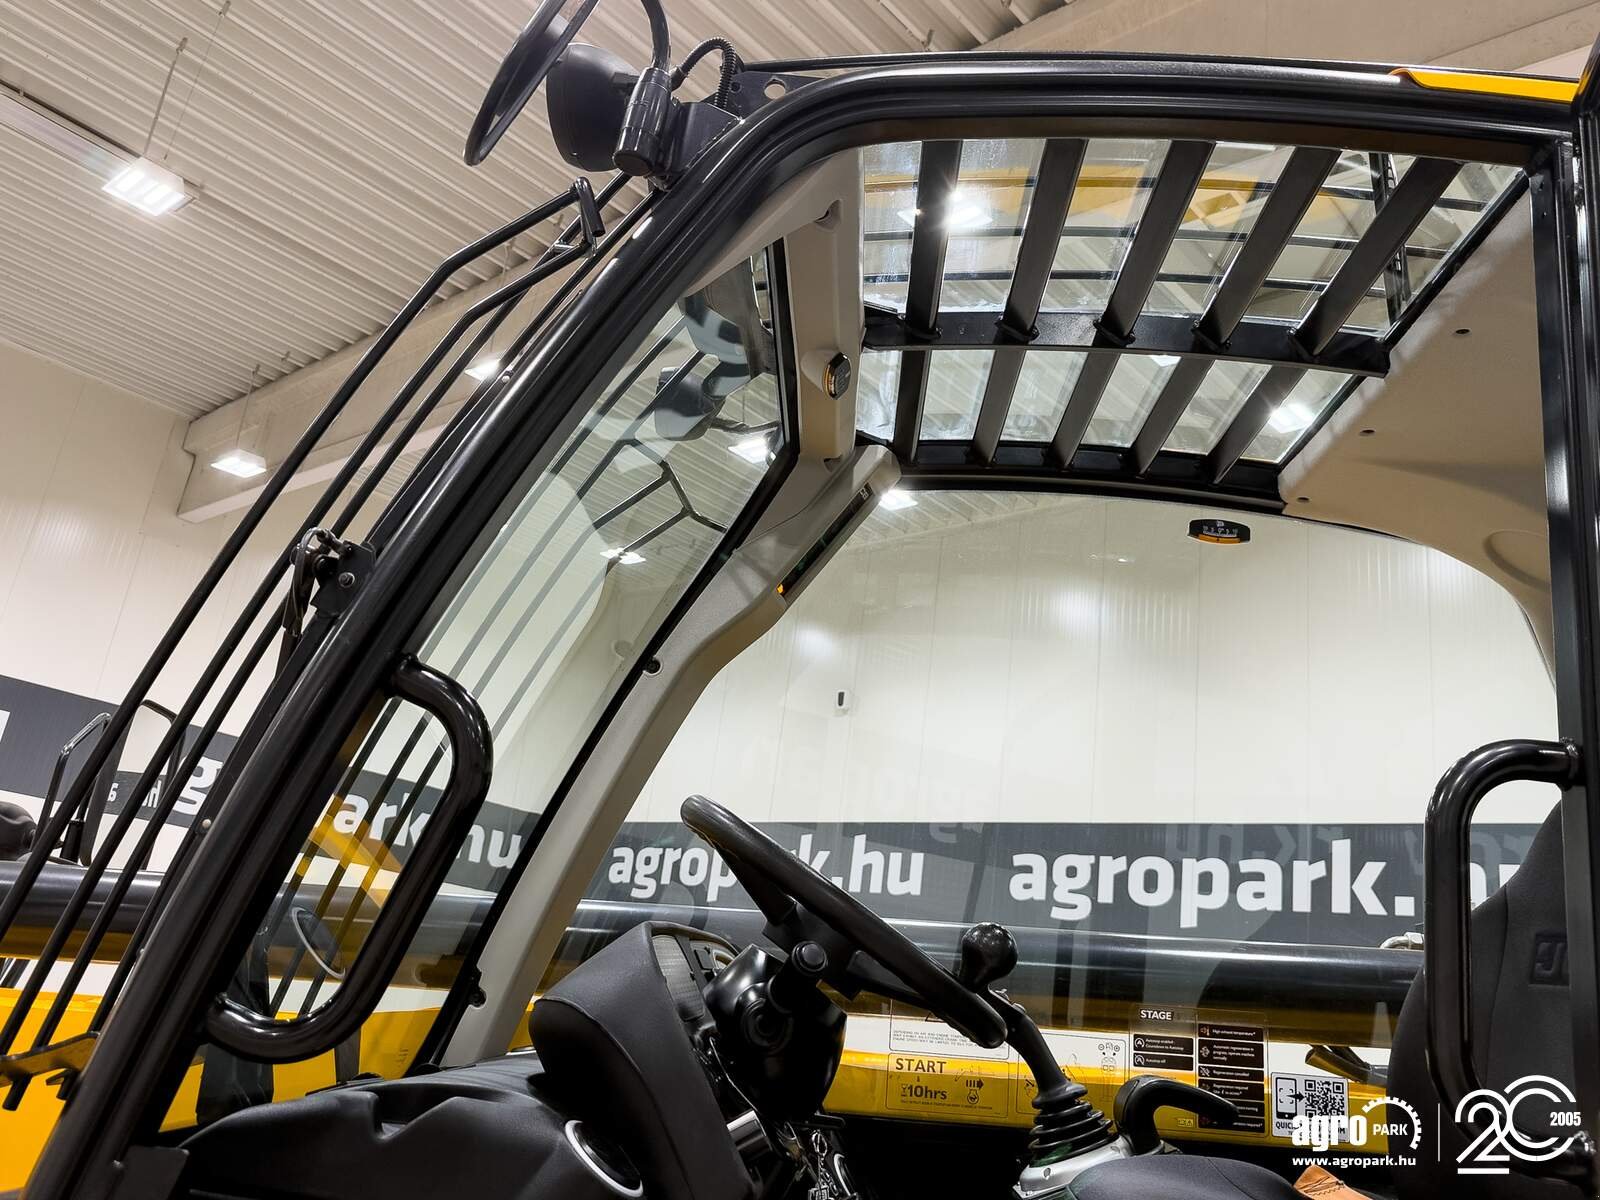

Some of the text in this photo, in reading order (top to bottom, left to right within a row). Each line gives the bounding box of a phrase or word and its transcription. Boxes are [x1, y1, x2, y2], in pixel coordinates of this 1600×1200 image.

[1140, 1009, 1172, 1020] STAGE
[895, 1057, 947, 1074] START
[907, 1083, 948, 1100] 10hrs
